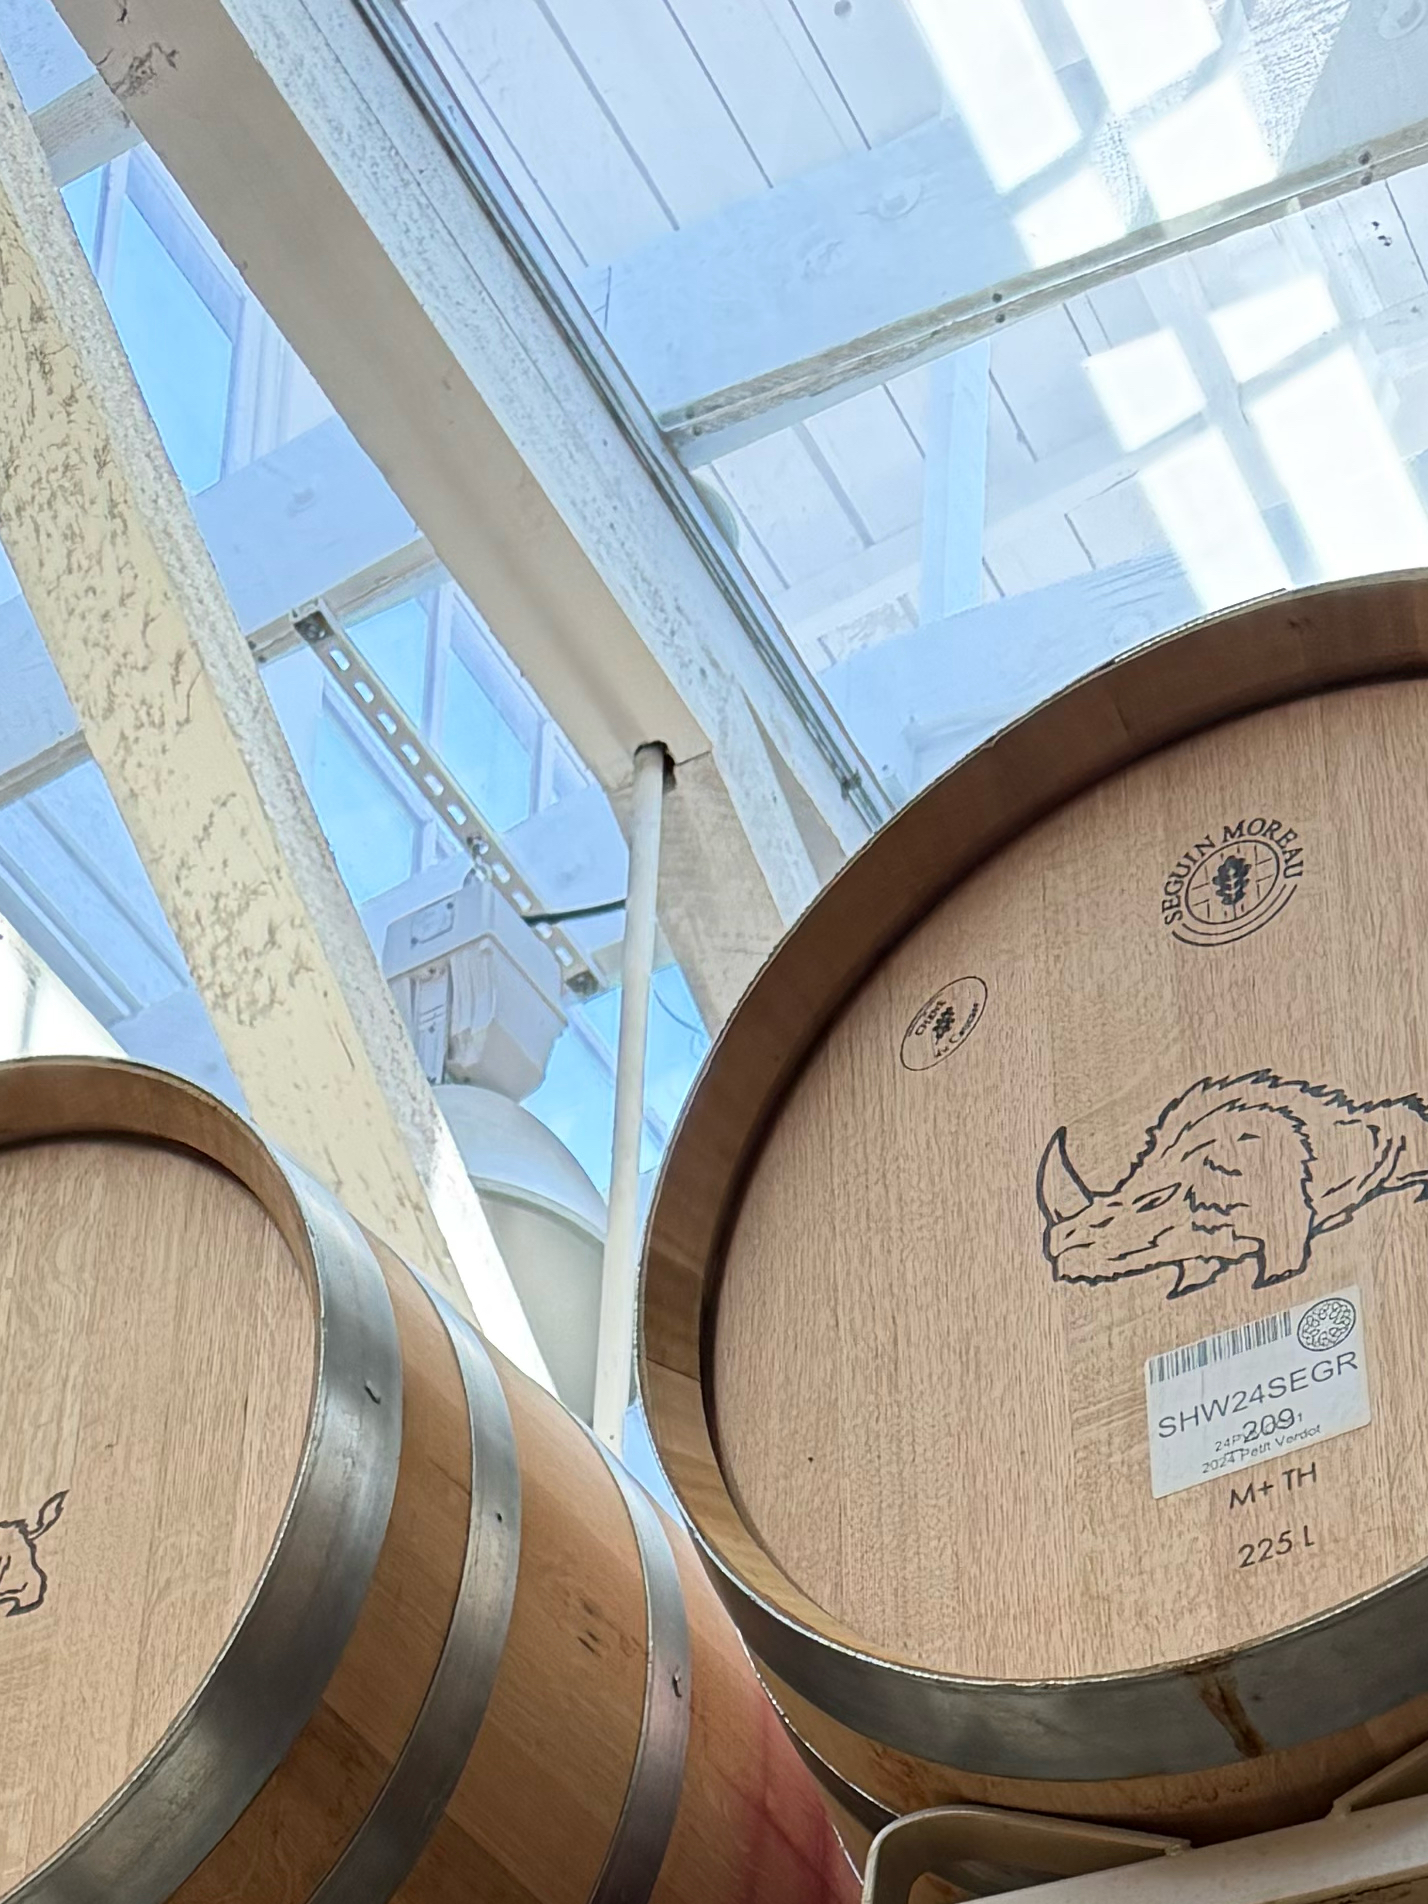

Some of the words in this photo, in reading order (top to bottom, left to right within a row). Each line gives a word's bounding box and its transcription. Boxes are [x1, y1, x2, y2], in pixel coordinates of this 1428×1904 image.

[1161, 834, 1216, 926] SEGUIN
[1221, 817, 1304, 879] MOREAU
[1158, 1350, 1359, 1439] SHW24SEGR
[1281, 1461, 1317, 1491] TH
[1237, 1529, 1293, 1569] 225
